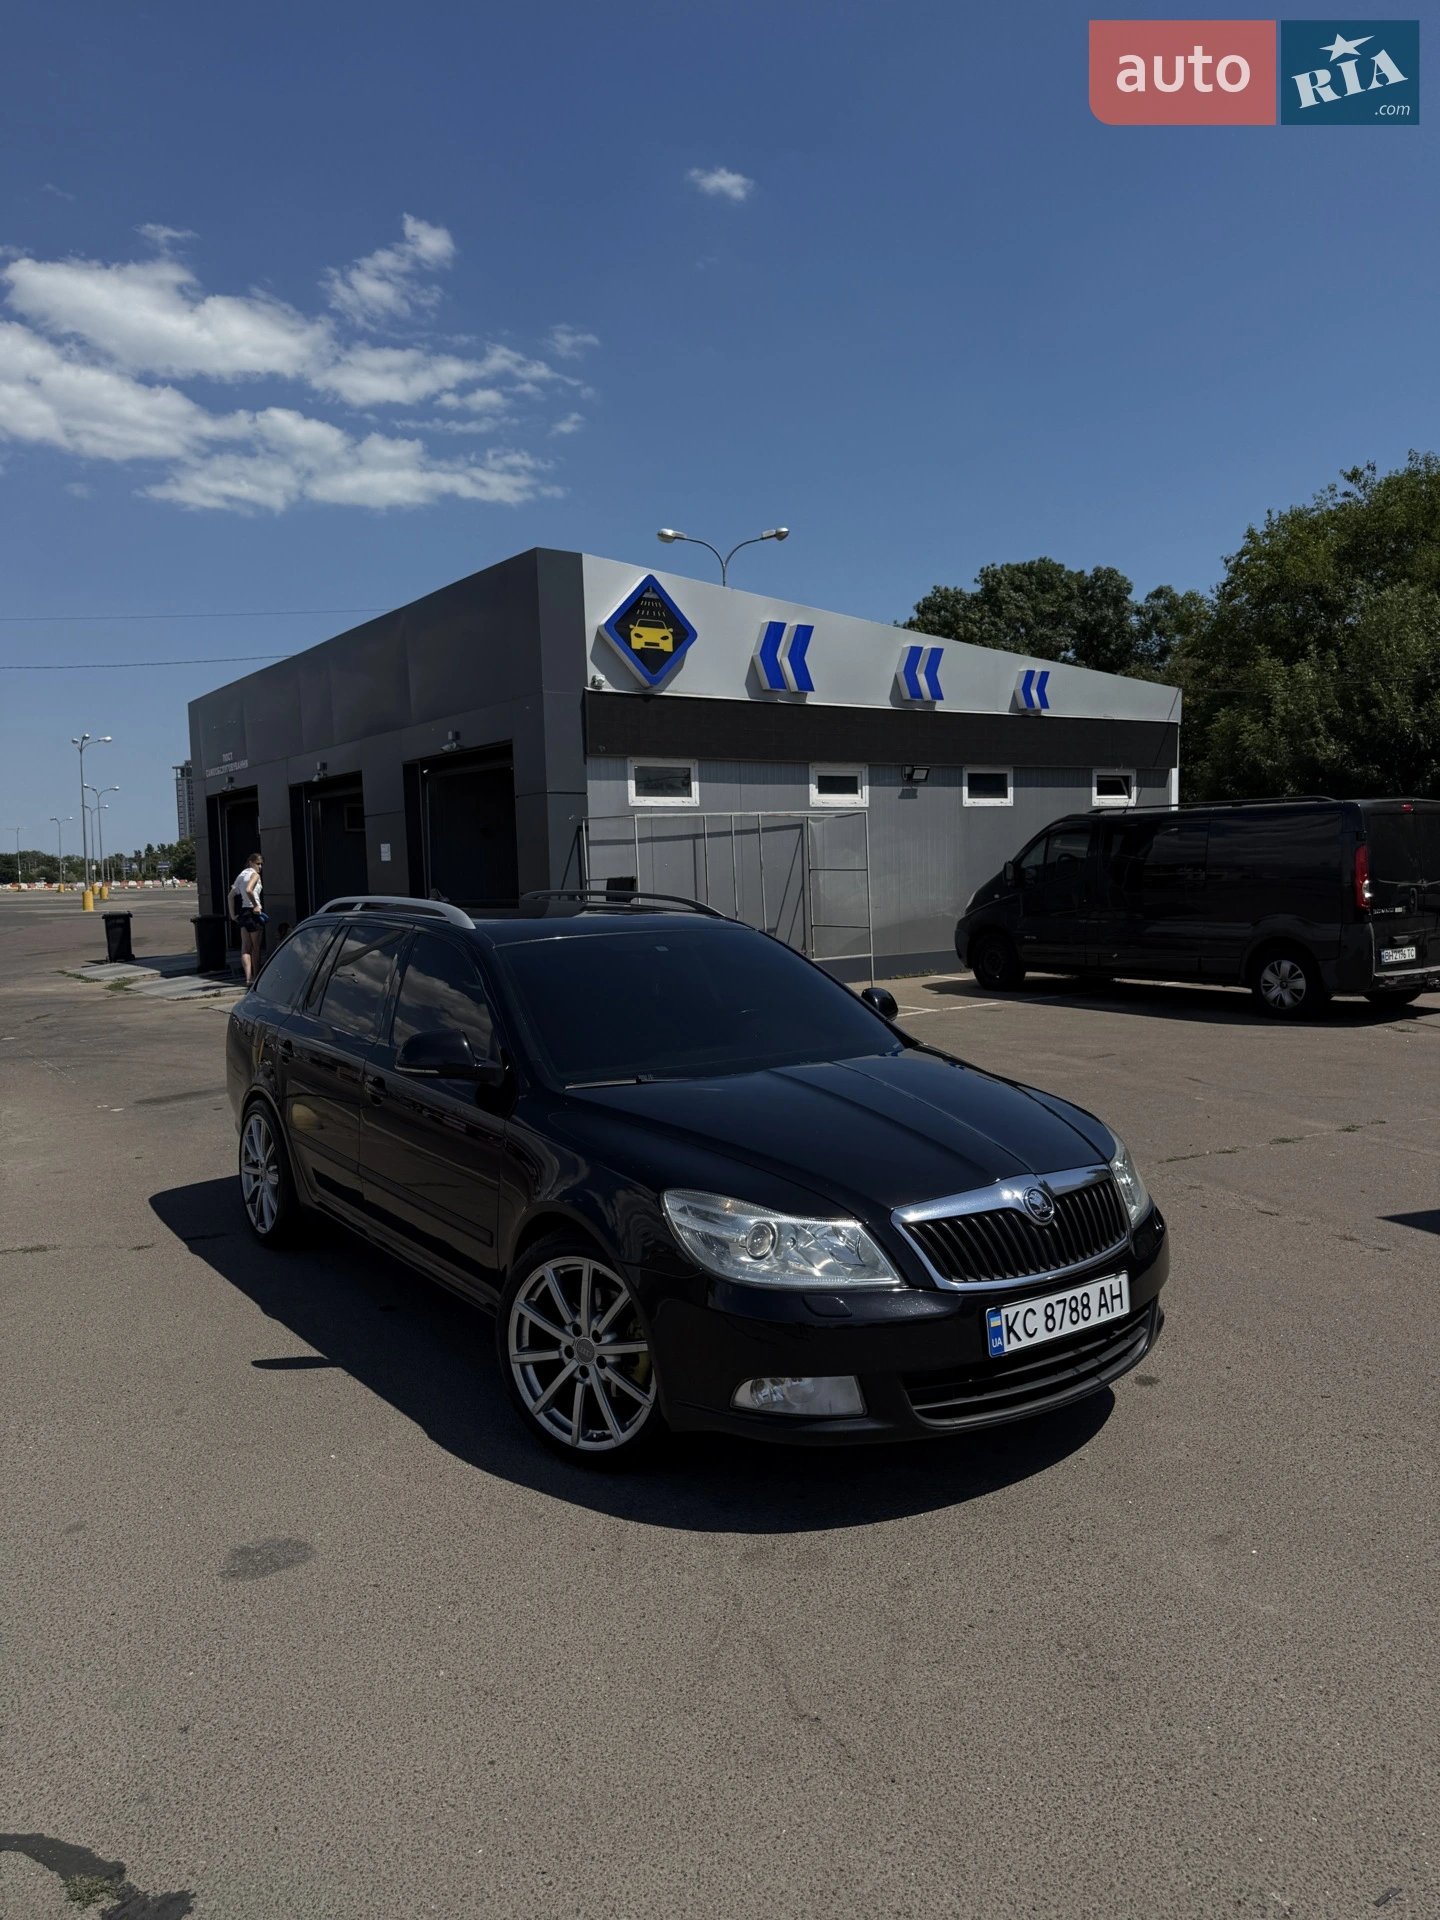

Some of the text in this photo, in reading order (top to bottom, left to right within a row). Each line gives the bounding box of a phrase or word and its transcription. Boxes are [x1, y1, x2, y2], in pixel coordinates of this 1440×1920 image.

[1005, 1280, 1124, 1345] KC 8788 AH
[992, 1338, 1003, 1348] UA
